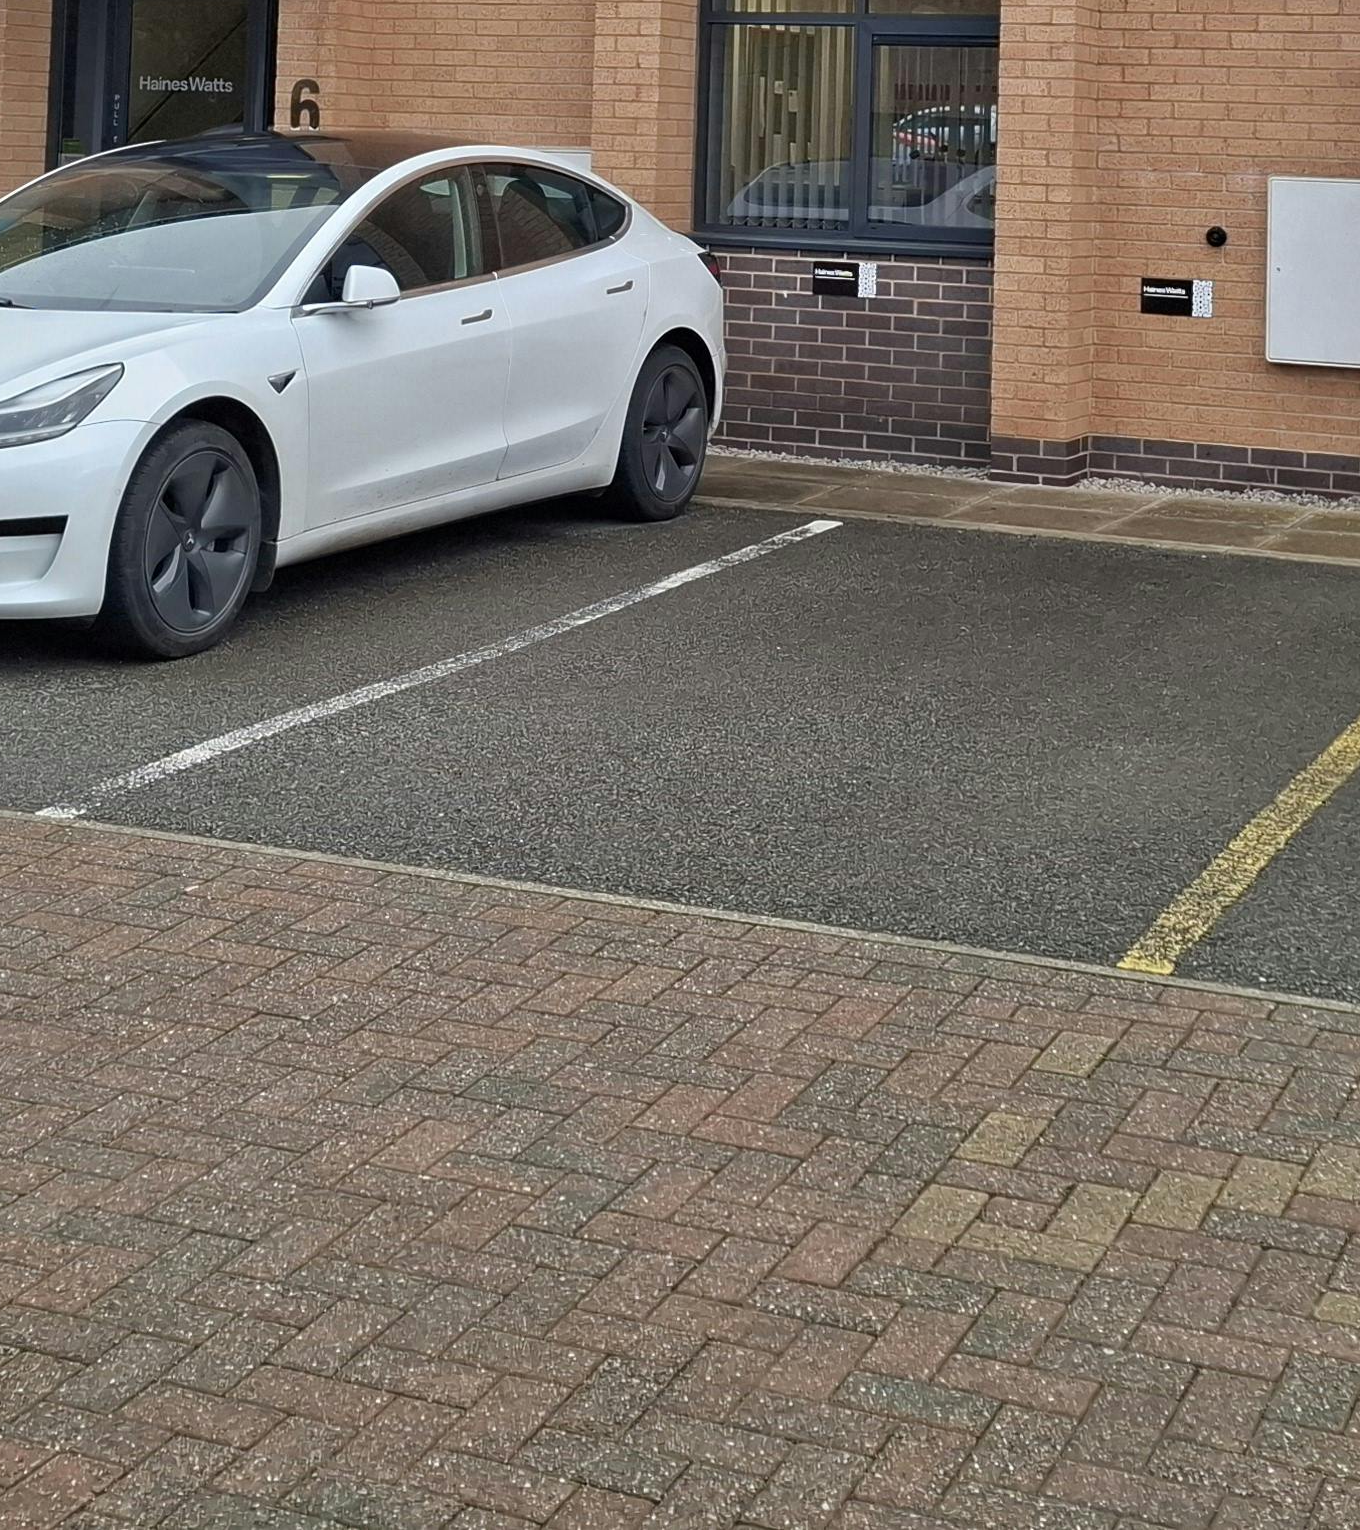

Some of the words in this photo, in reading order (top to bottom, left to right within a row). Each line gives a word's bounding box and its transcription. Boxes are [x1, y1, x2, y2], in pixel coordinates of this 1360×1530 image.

[139, 75, 188, 91] Haines
[188, 76, 233, 92] Watts
[291, 79, 320, 130] 6
